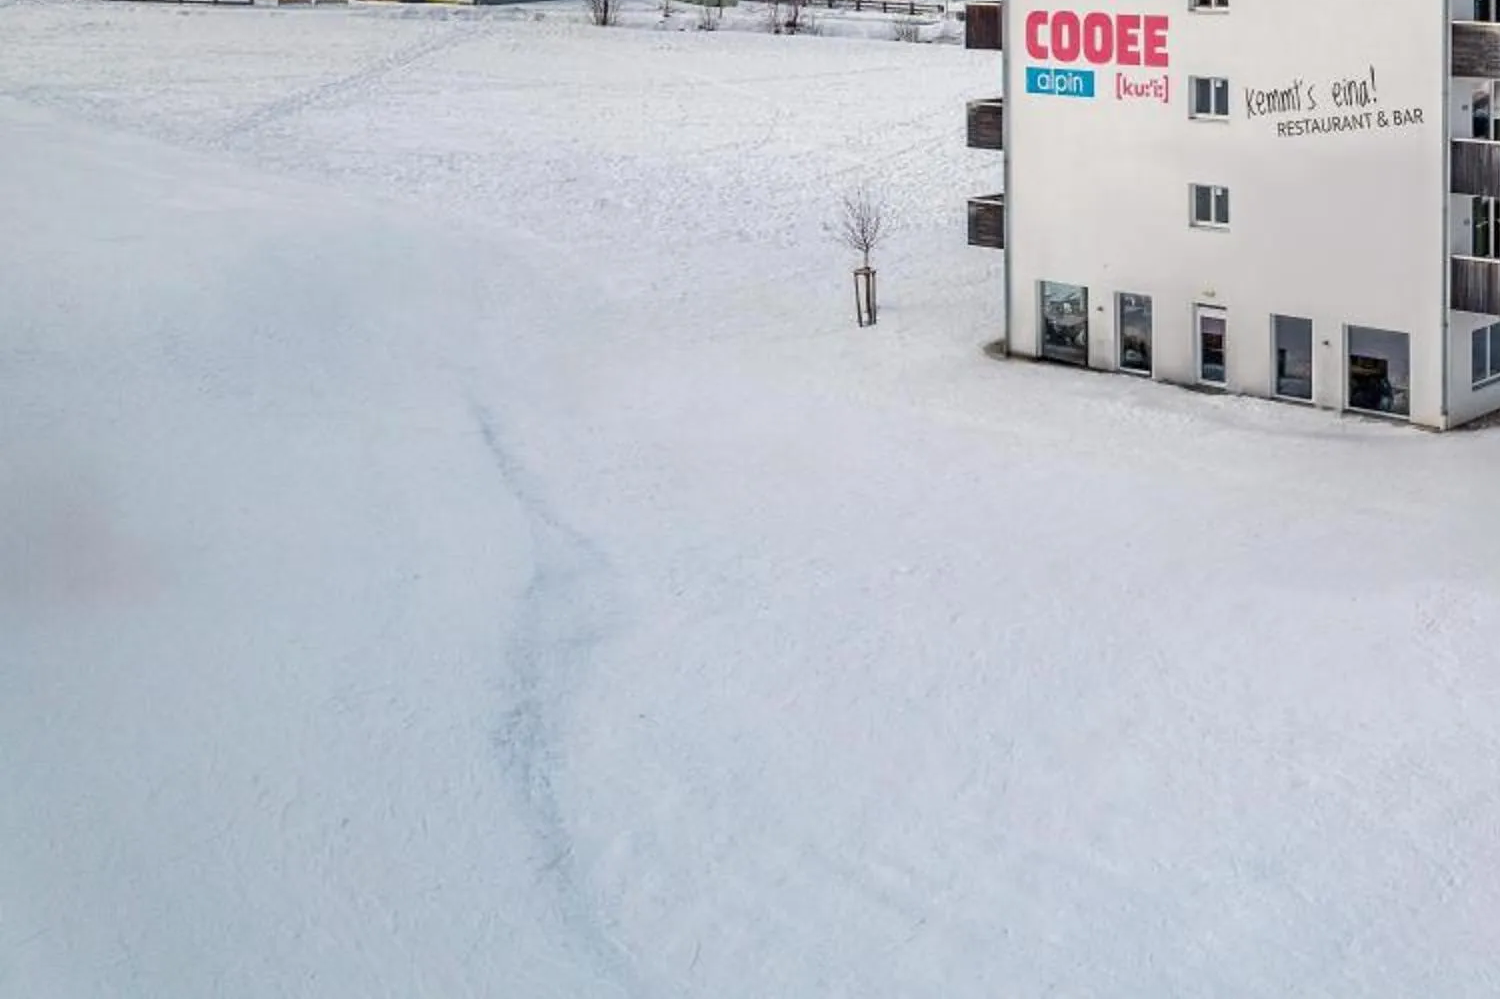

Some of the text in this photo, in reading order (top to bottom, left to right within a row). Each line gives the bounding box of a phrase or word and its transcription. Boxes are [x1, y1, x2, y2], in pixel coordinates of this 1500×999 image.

[1025, 10, 1169, 68] COOEE
[1037, 70, 1084, 96] alpin
[1277, 108, 1425, 137] RESTAURANT & BAR
